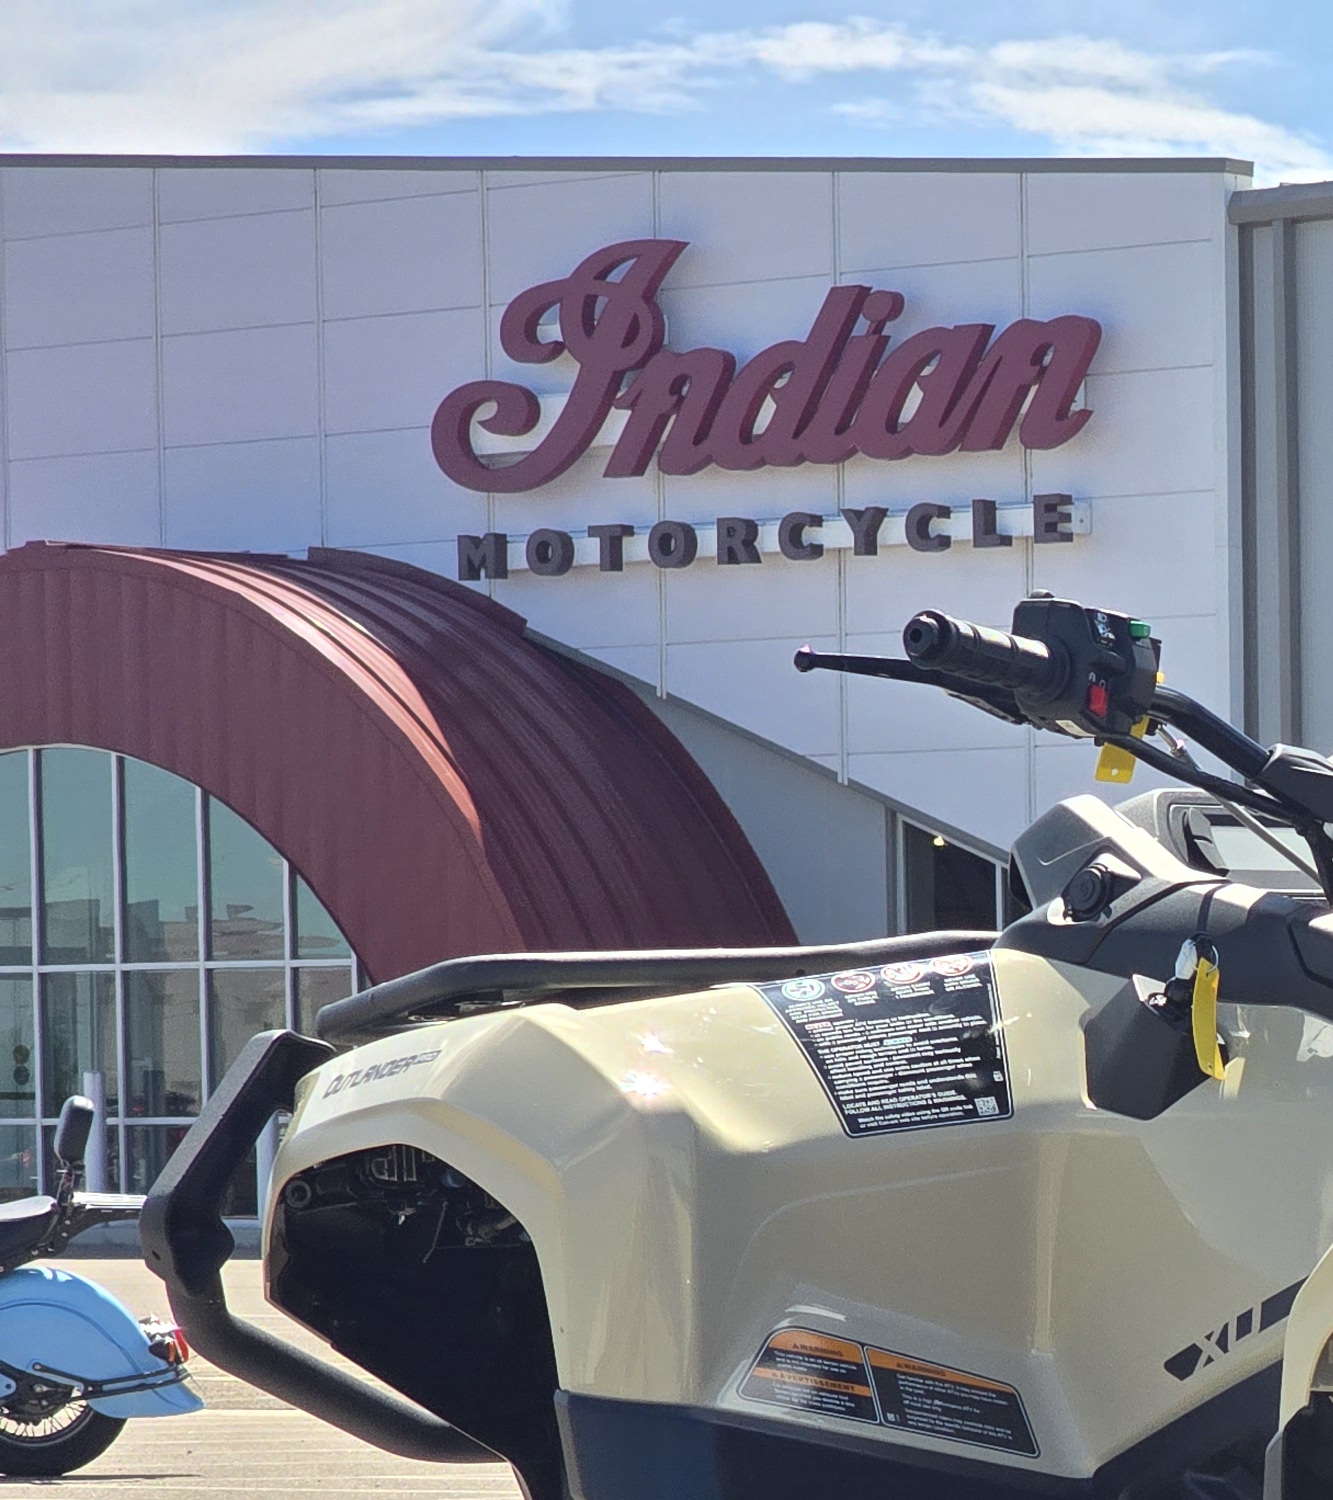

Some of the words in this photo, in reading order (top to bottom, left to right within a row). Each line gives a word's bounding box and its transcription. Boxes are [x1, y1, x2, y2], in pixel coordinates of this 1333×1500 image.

[431, 239, 1102, 493] Indian
[457, 494, 1074, 581] MOTORCYCLE
[322, 1054, 418, 1099] OUTLANDER
